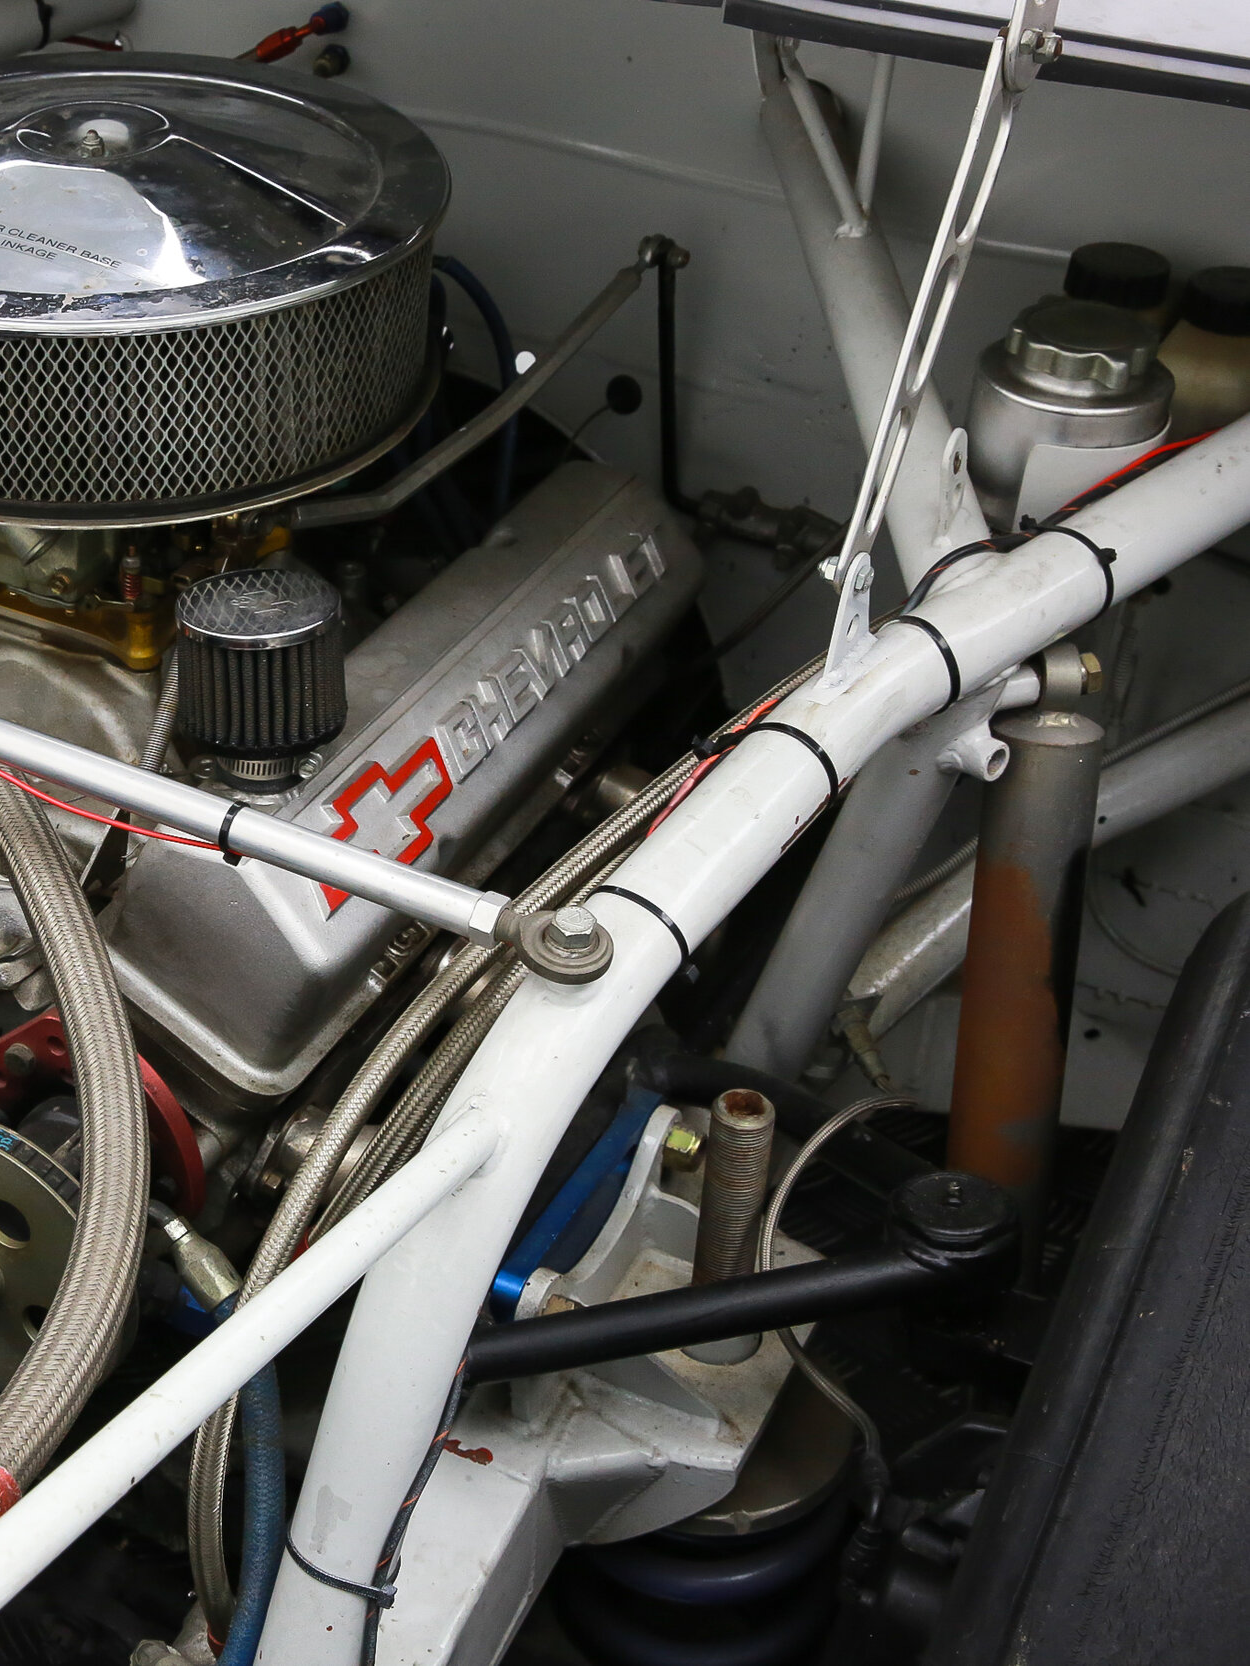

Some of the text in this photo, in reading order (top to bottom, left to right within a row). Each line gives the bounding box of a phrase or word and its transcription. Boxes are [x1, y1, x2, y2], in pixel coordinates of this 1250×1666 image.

[8, 228, 78, 254] CLEANER
[80, 250, 122, 269] BASE
[435, 532, 667, 785] CHEVROLET
